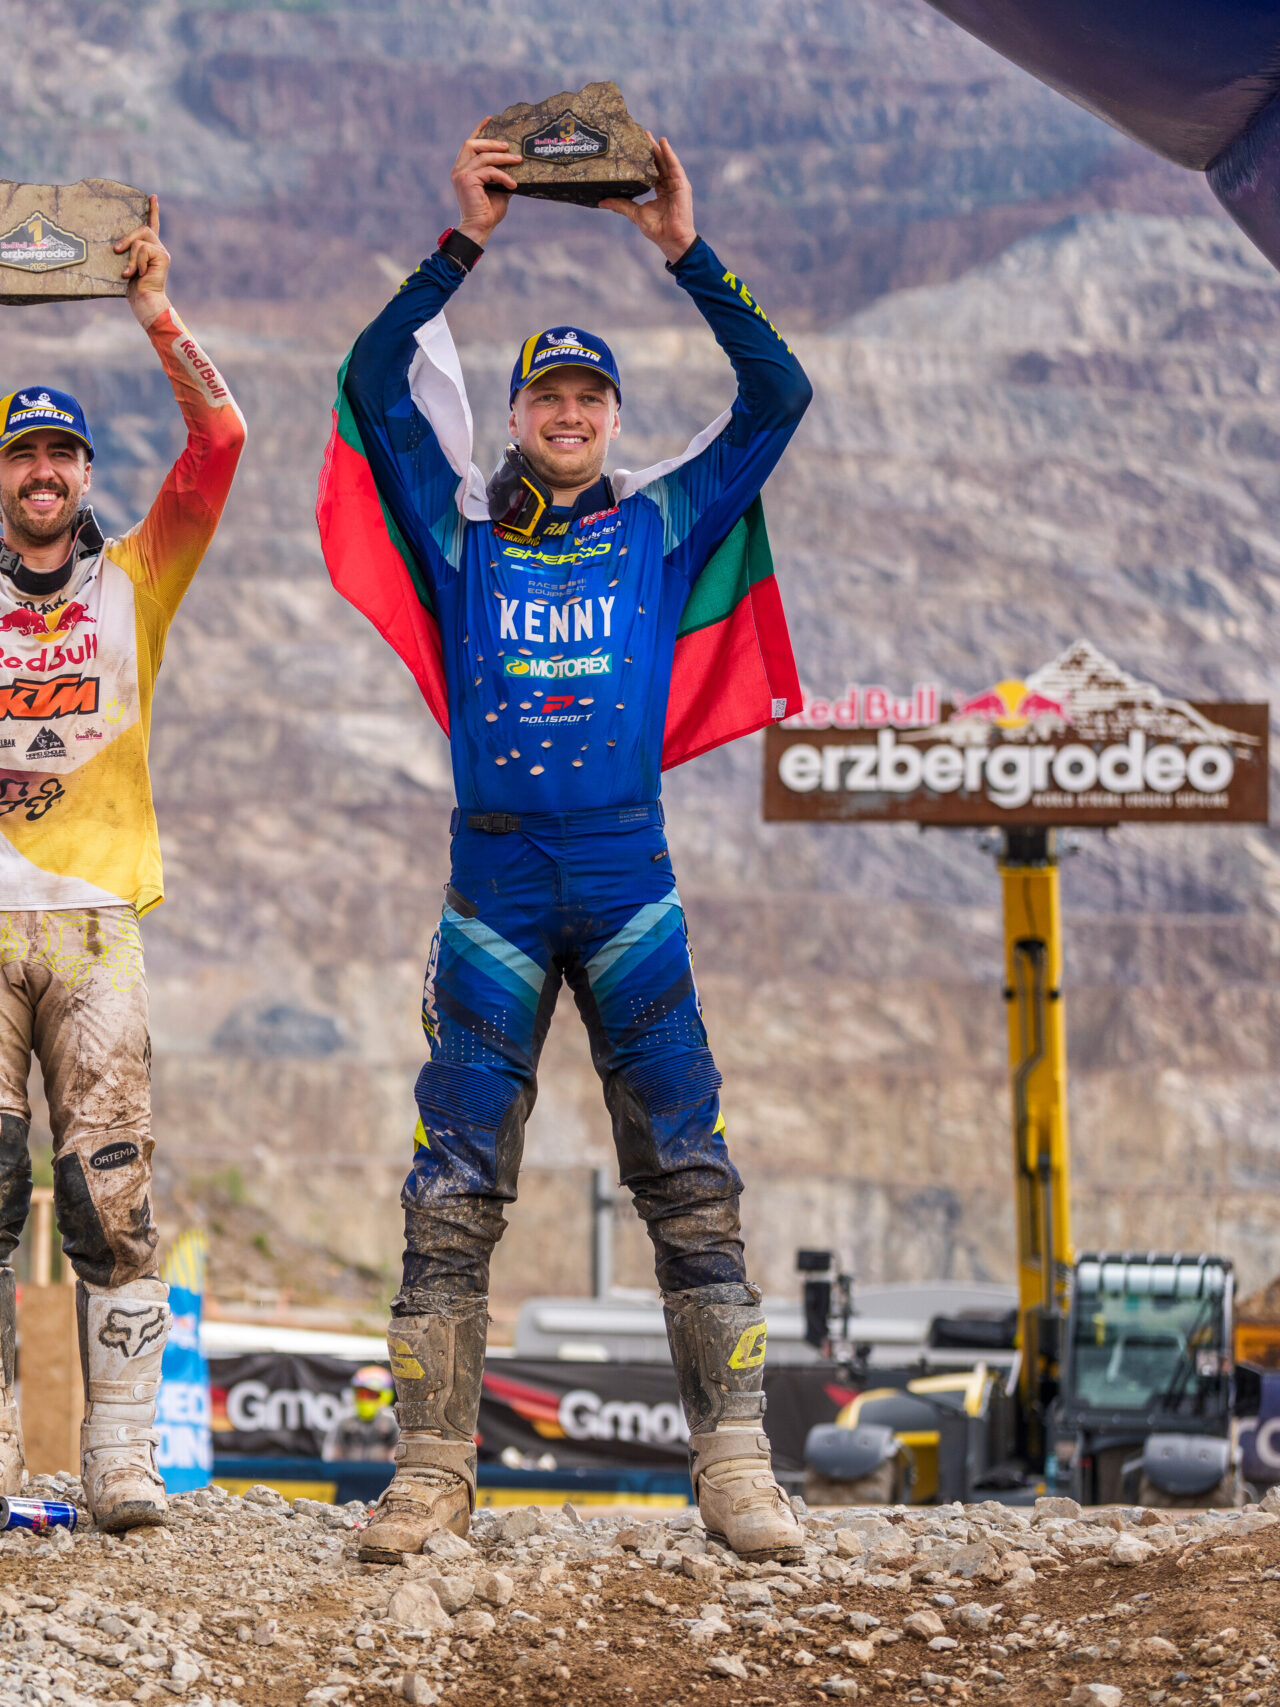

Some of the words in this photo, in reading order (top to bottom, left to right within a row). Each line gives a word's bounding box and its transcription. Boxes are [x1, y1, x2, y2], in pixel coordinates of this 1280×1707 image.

[560, 119, 575, 138] 3
[534, 143, 599, 154] erzbergrodeo
[28, 220, 43, 242] 1
[1, 248, 75, 260] erzbergrodeo
[30, 263, 47, 271] 2025
[534, 347, 601, 363] MICHELIN
[180, 340, 209, 369] Red
[199, 368, 226, 399] Bull
[9, 410, 73, 425] MICHELIN
[500, 596, 615, 643] KENNY
[47, 633, 98, 672] Bull
[530, 655, 610, 678] MOTOREX
[862, 682, 940, 731] Bull
[519, 713, 593, 724] POLISPORT
[778, 729, 1235, 810] erzbergrodeo
[93, 1145, 137, 1167] ORTEMA
